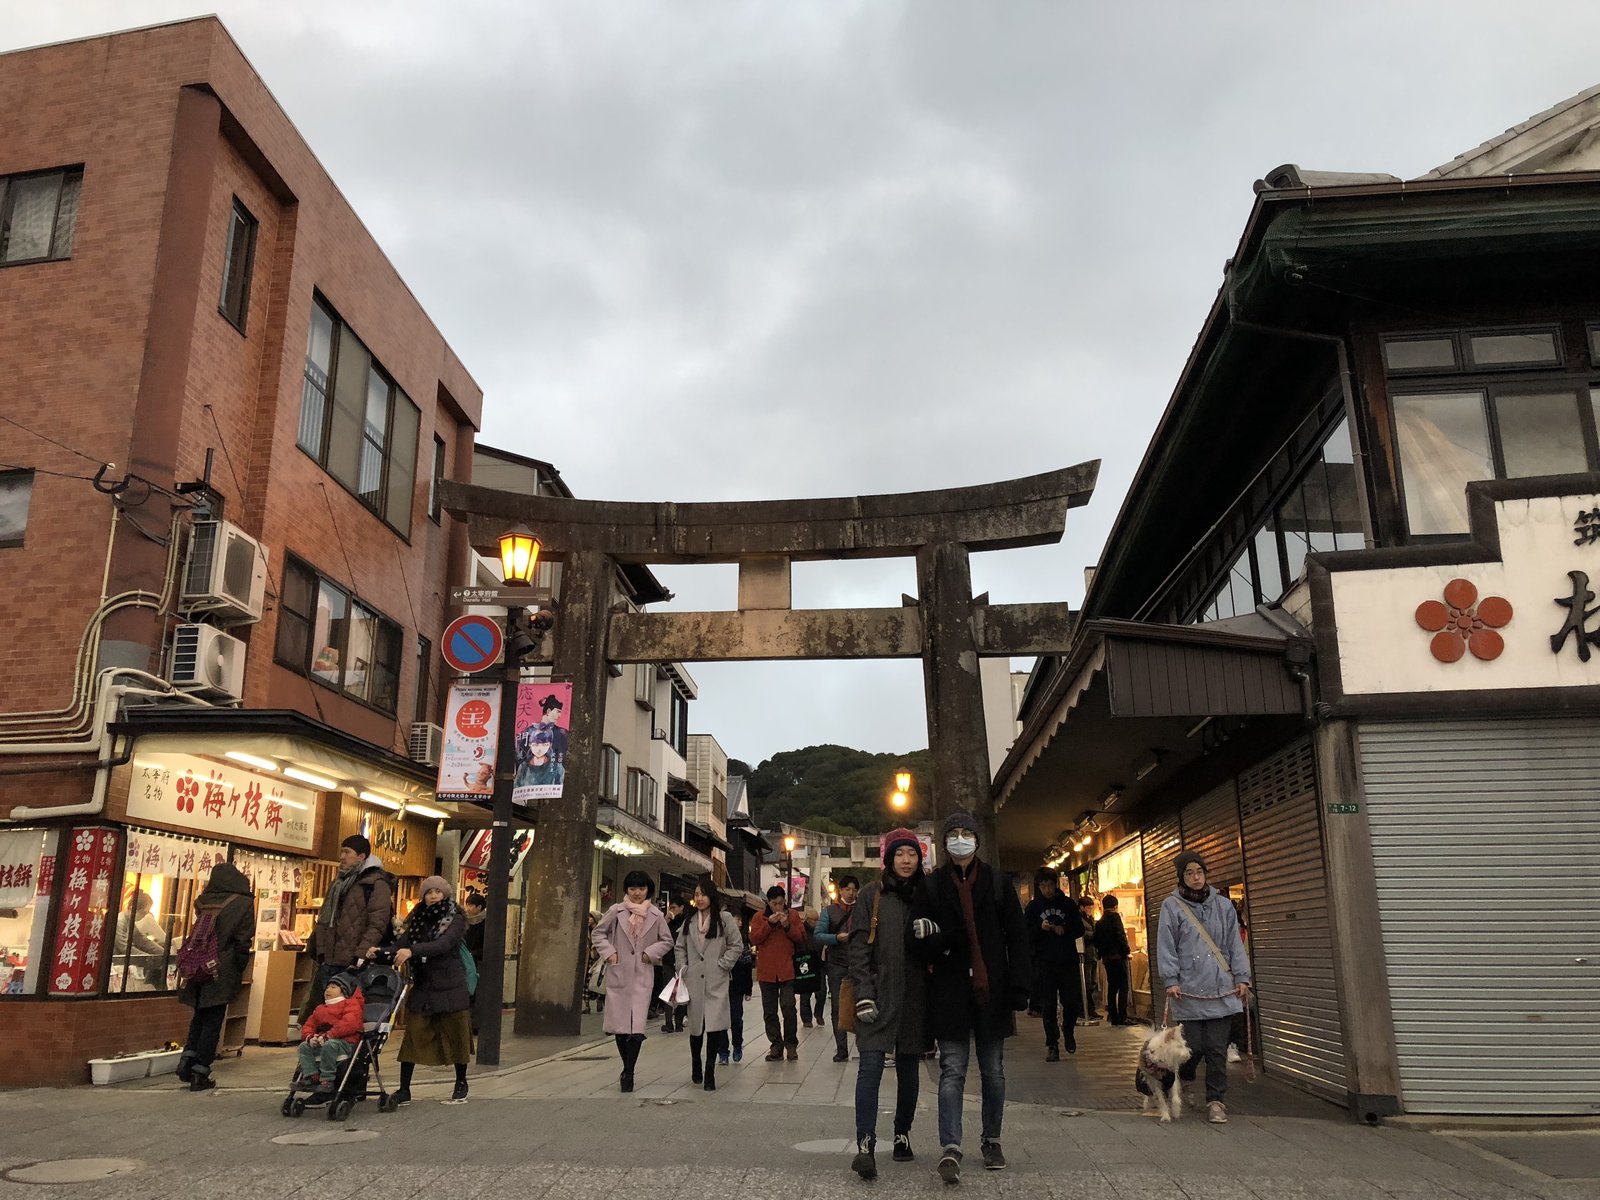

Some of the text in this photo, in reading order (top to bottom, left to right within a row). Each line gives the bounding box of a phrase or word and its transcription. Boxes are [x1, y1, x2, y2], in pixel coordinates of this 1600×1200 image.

[462, 710, 485, 726] 玉
[515, 686, 533, 748] 応天の門
[143, 784, 163, 801] 名物
